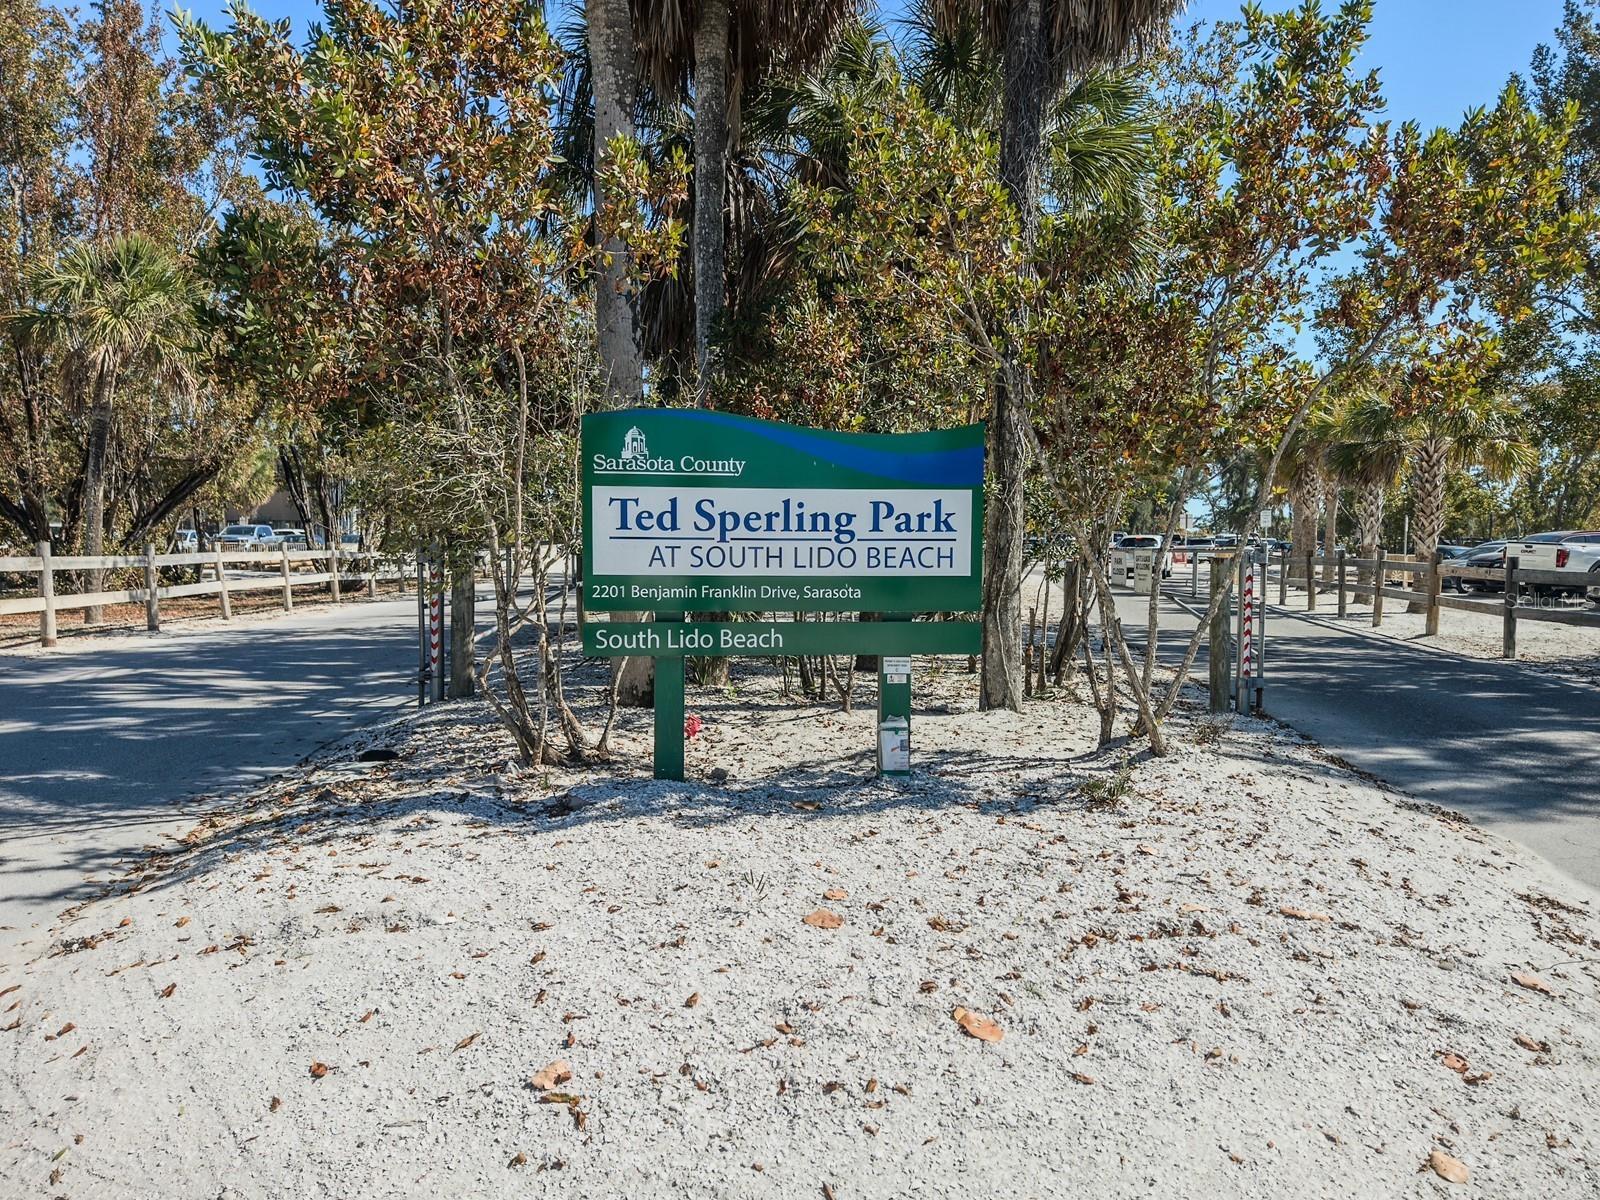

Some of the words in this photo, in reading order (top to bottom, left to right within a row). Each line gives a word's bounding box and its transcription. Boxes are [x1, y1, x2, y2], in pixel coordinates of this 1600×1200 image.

[593, 454, 675, 471] Sarasota
[680, 455, 746, 476] County
[608, 496, 681, 532] Ted
[693, 497, 857, 544] Sperling
[869, 498, 957, 533] Park
[648, 545, 682, 568] AT
[690, 545, 783, 569] SOUTH
[794, 546, 857, 569] LIDO
[866, 546, 954, 569] BEACH
[592, 585, 626, 598] 2201
[631, 585, 697, 601] Benjamin
[701, 585, 757, 599] Franklin
[760, 586, 800, 600] Drive,
[803, 586, 861, 600] Sarasota
[595, 628, 660, 649] South
[667, 628, 714, 649] Lido
[720, 629, 784, 649] Beach
